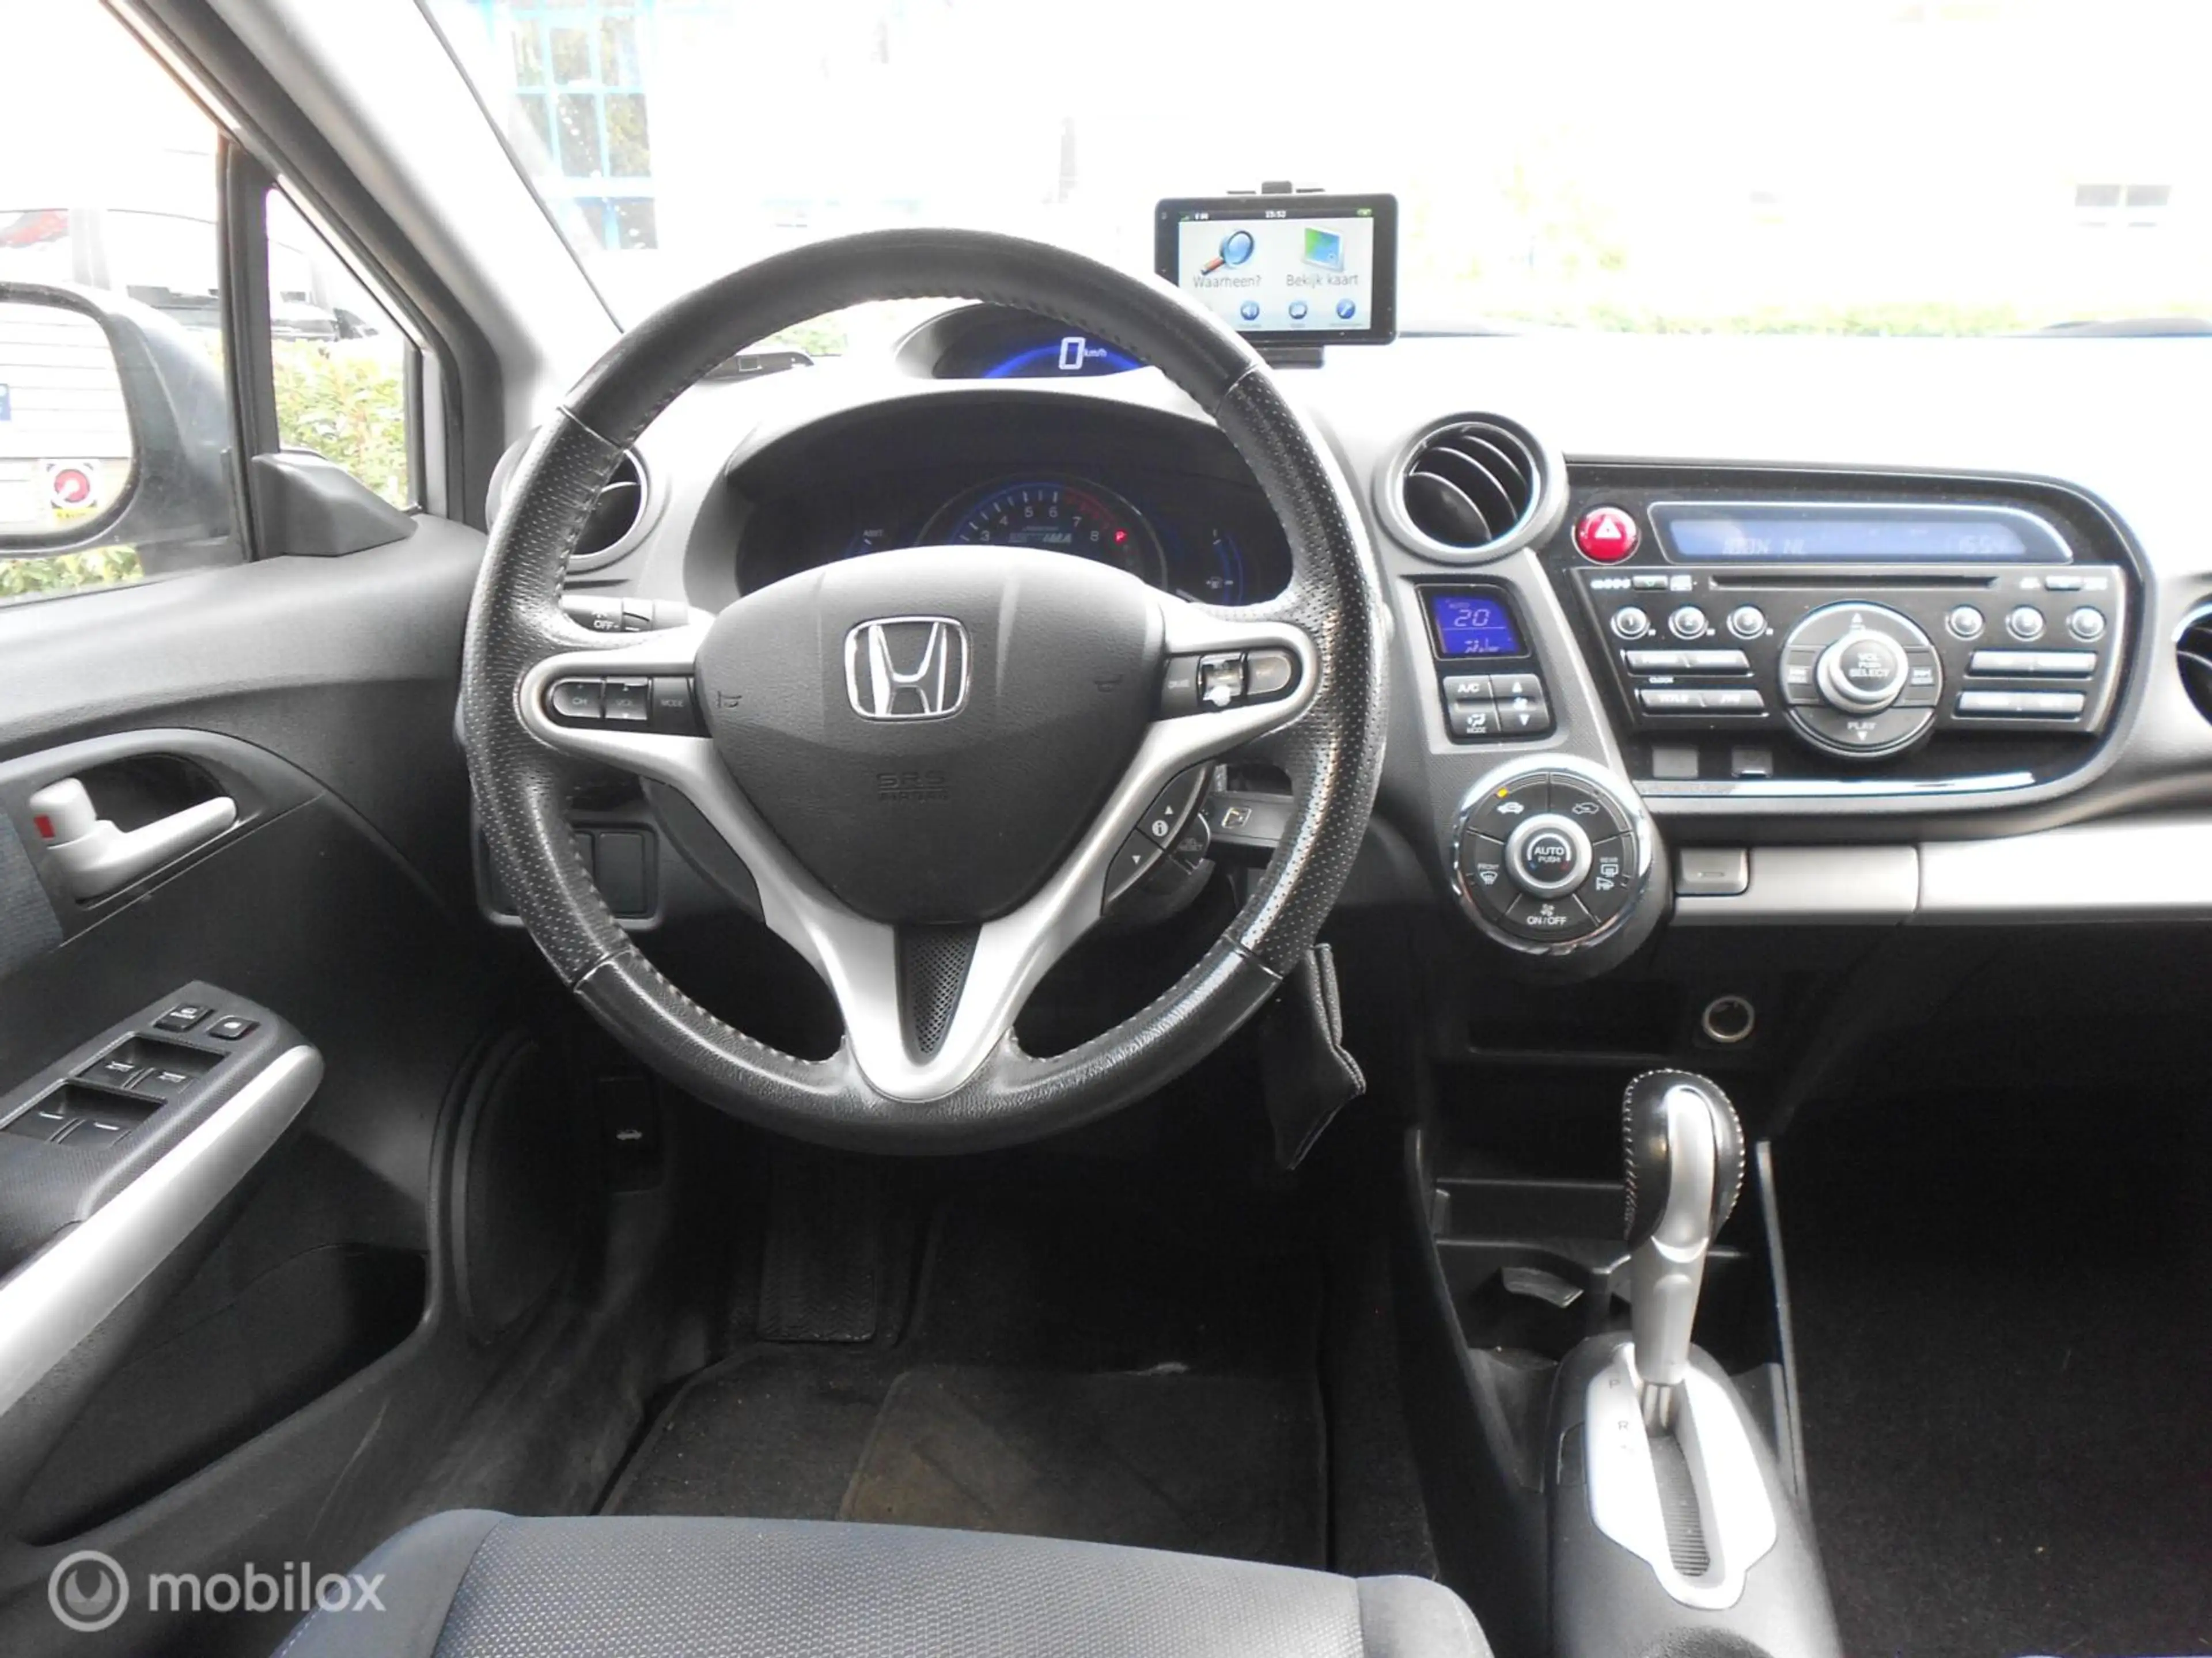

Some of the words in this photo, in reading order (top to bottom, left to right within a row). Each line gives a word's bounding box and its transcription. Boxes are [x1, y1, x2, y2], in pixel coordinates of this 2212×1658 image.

[1193, 274, 1262, 288] Waarheen?
[1286, 274, 1322, 289] Bekijk
[1327, 274, 1358, 286] kaart
[1059, 337, 1085, 370] 0
[1084, 347, 1107, 358] km/h
[1025, 506, 1033, 518] 5
[1048, 506, 1058, 518] 6
[999, 516, 1007, 525] 4
[1073, 516, 1082, 528] 7
[980, 530, 990, 541] 3
[1090, 530, 1099, 541] 8
[1454, 609, 1491, 627] 20
[1849, 669, 1890, 677] SELECT
[1458, 684, 1480, 693] A/C
[1847, 722, 1876, 730] PLAY
[1535, 847, 1565, 855] AUTO
